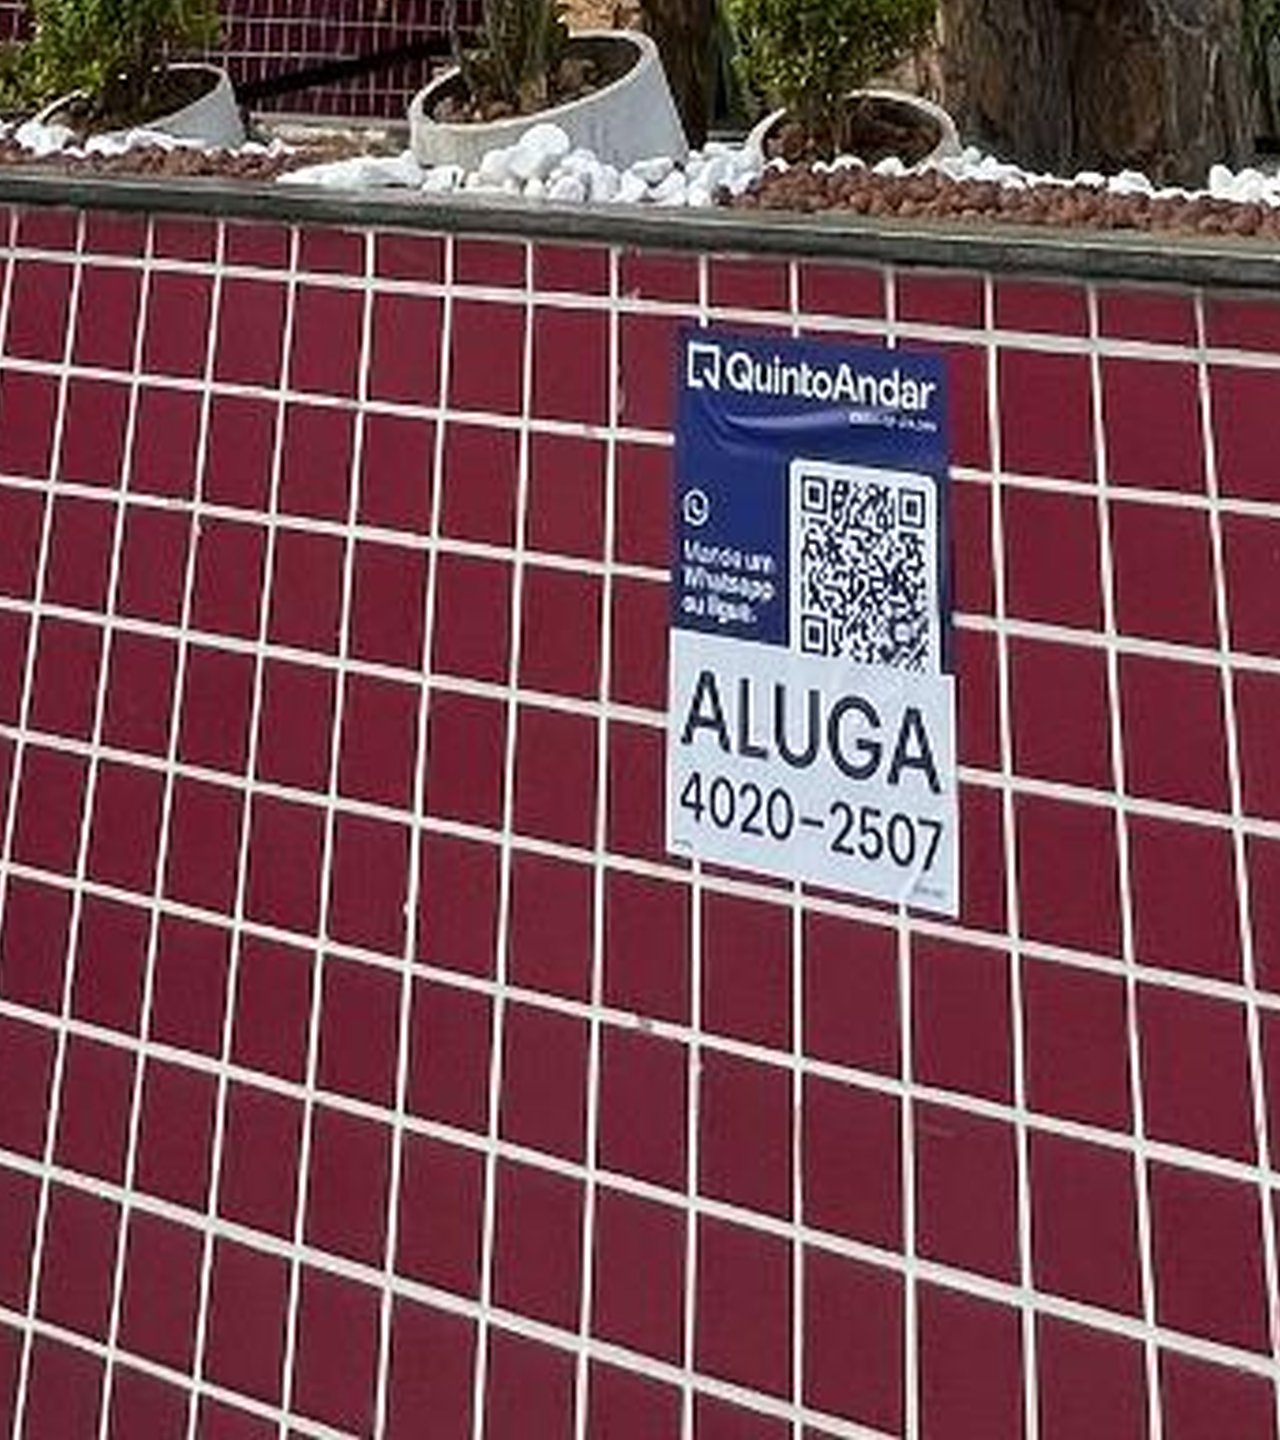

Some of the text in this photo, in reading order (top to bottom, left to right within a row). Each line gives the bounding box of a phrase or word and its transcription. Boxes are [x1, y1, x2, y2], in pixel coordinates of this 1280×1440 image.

[725, 351, 936, 411] QuintoAndar
[680, 670, 942, 794] ALUGA
[680, 772, 943, 872] 4020-2507
